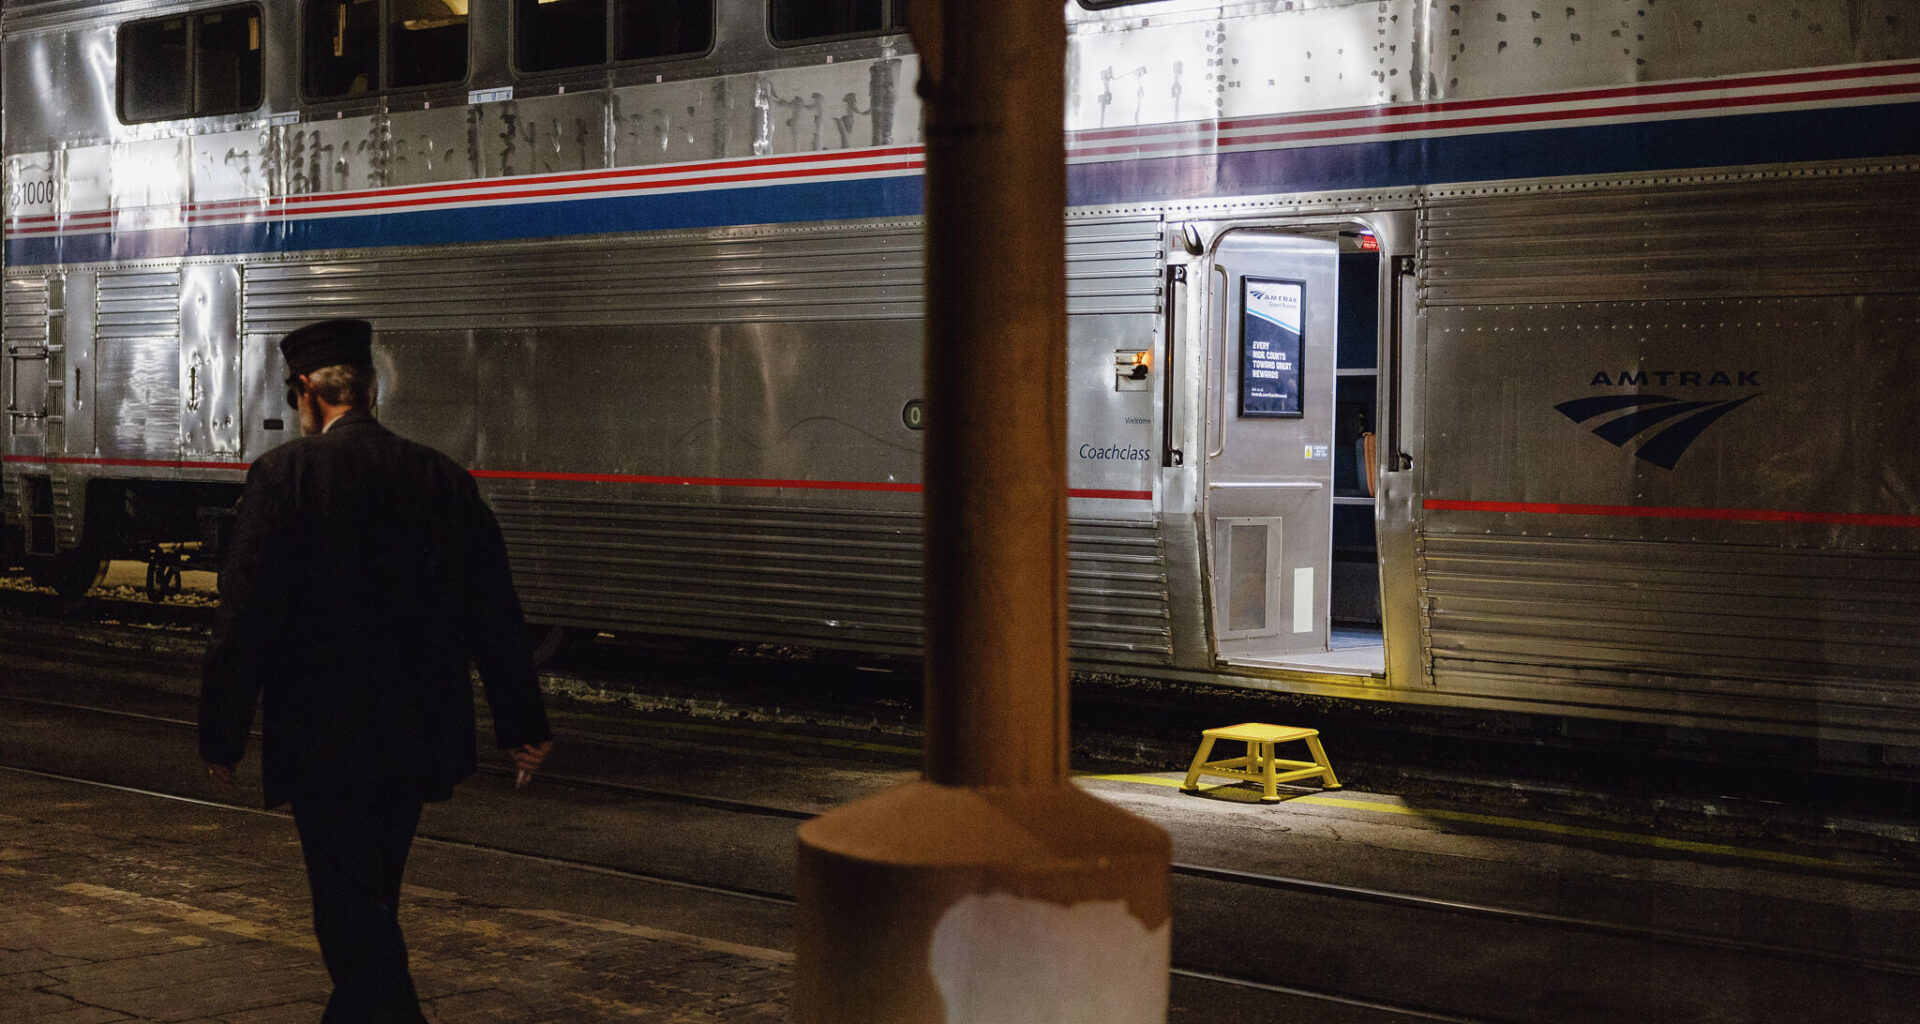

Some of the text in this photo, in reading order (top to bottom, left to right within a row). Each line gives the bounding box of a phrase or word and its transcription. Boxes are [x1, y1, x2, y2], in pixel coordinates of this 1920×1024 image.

[1252, 341, 1270, 350] EVERY
[1590, 370, 1760, 386] AMTRAK
[1124, 416, 1152, 425] Welcome
[1079, 443, 1151, 461] Coachclass
